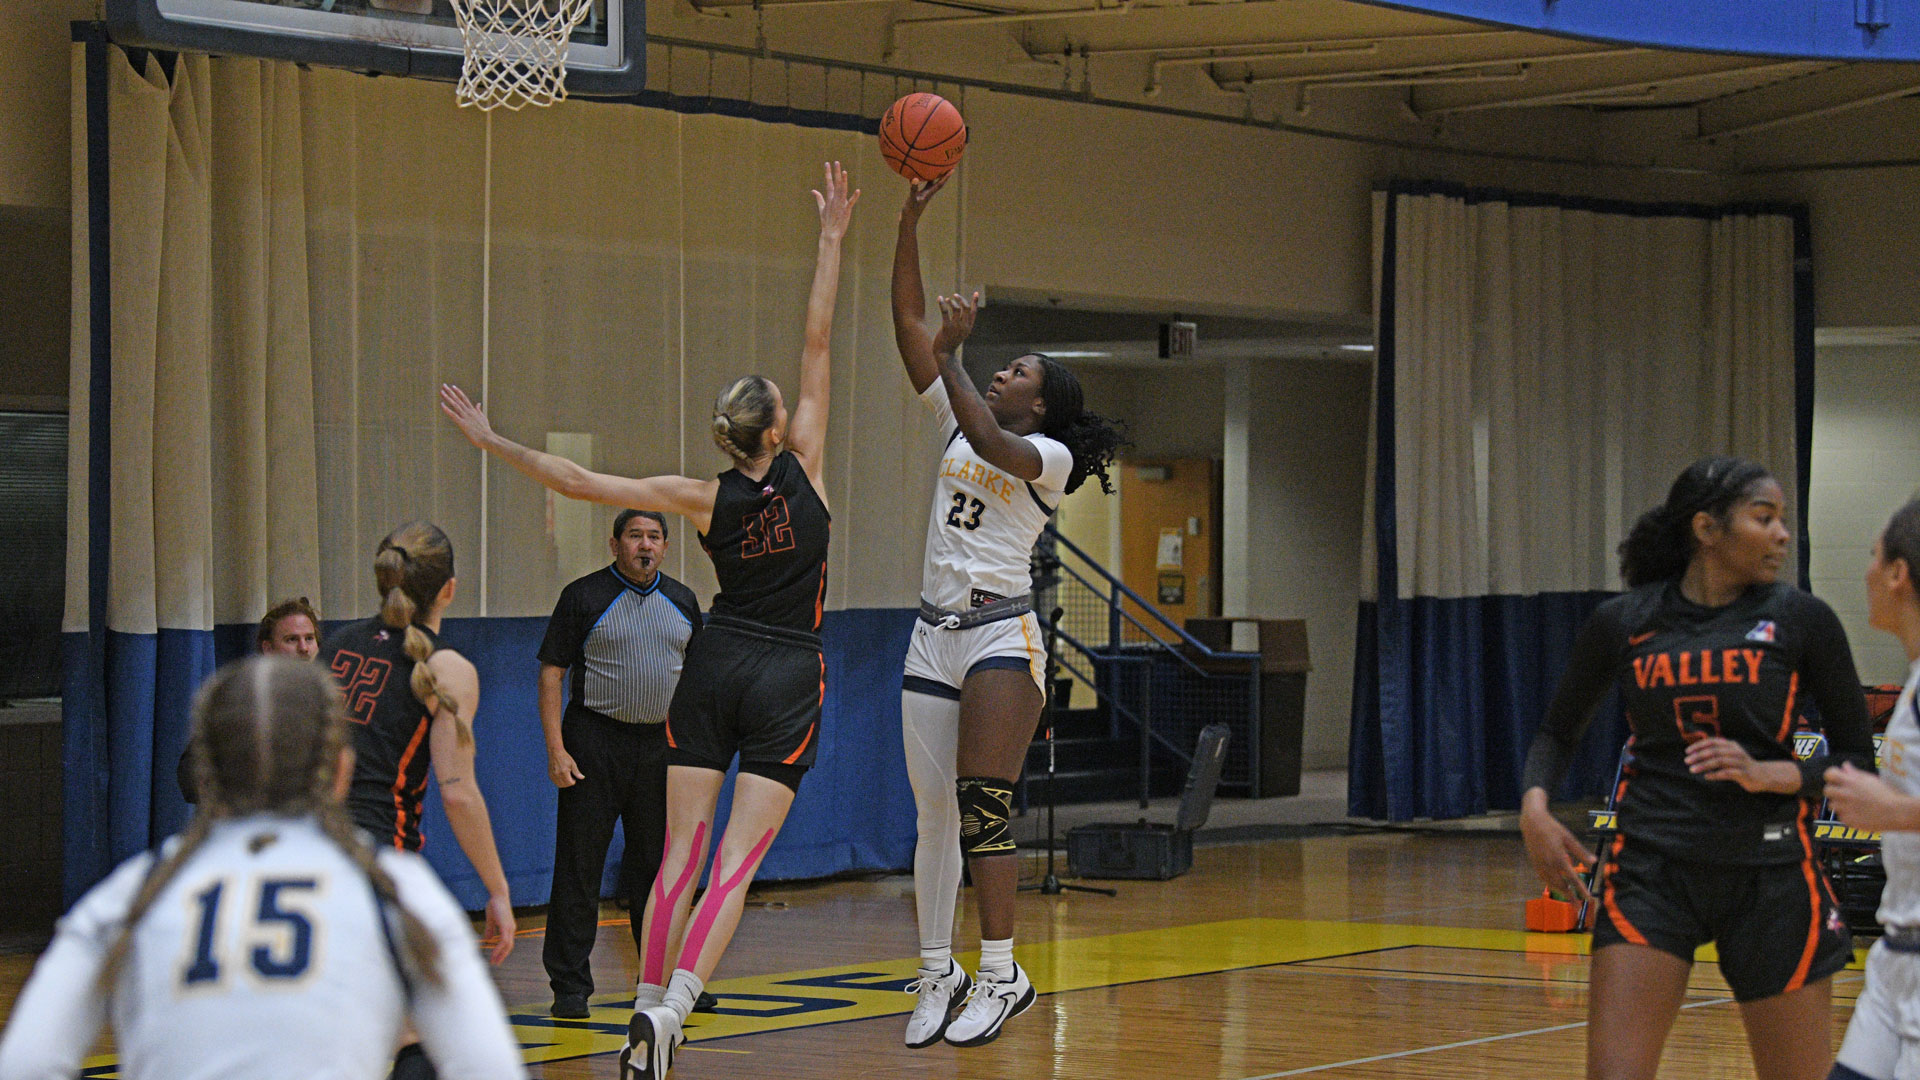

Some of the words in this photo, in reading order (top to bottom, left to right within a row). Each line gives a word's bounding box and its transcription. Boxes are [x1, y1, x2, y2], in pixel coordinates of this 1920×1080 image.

[939, 457, 1015, 505] CLARKE
[741, 495, 796, 560] 32
[945, 489, 987, 532] 23
[330, 649, 393, 726] 22
[1632, 648, 1765, 690] VALLEY
[1673, 695, 1721, 745] 5
[181, 872, 322, 990] 15
